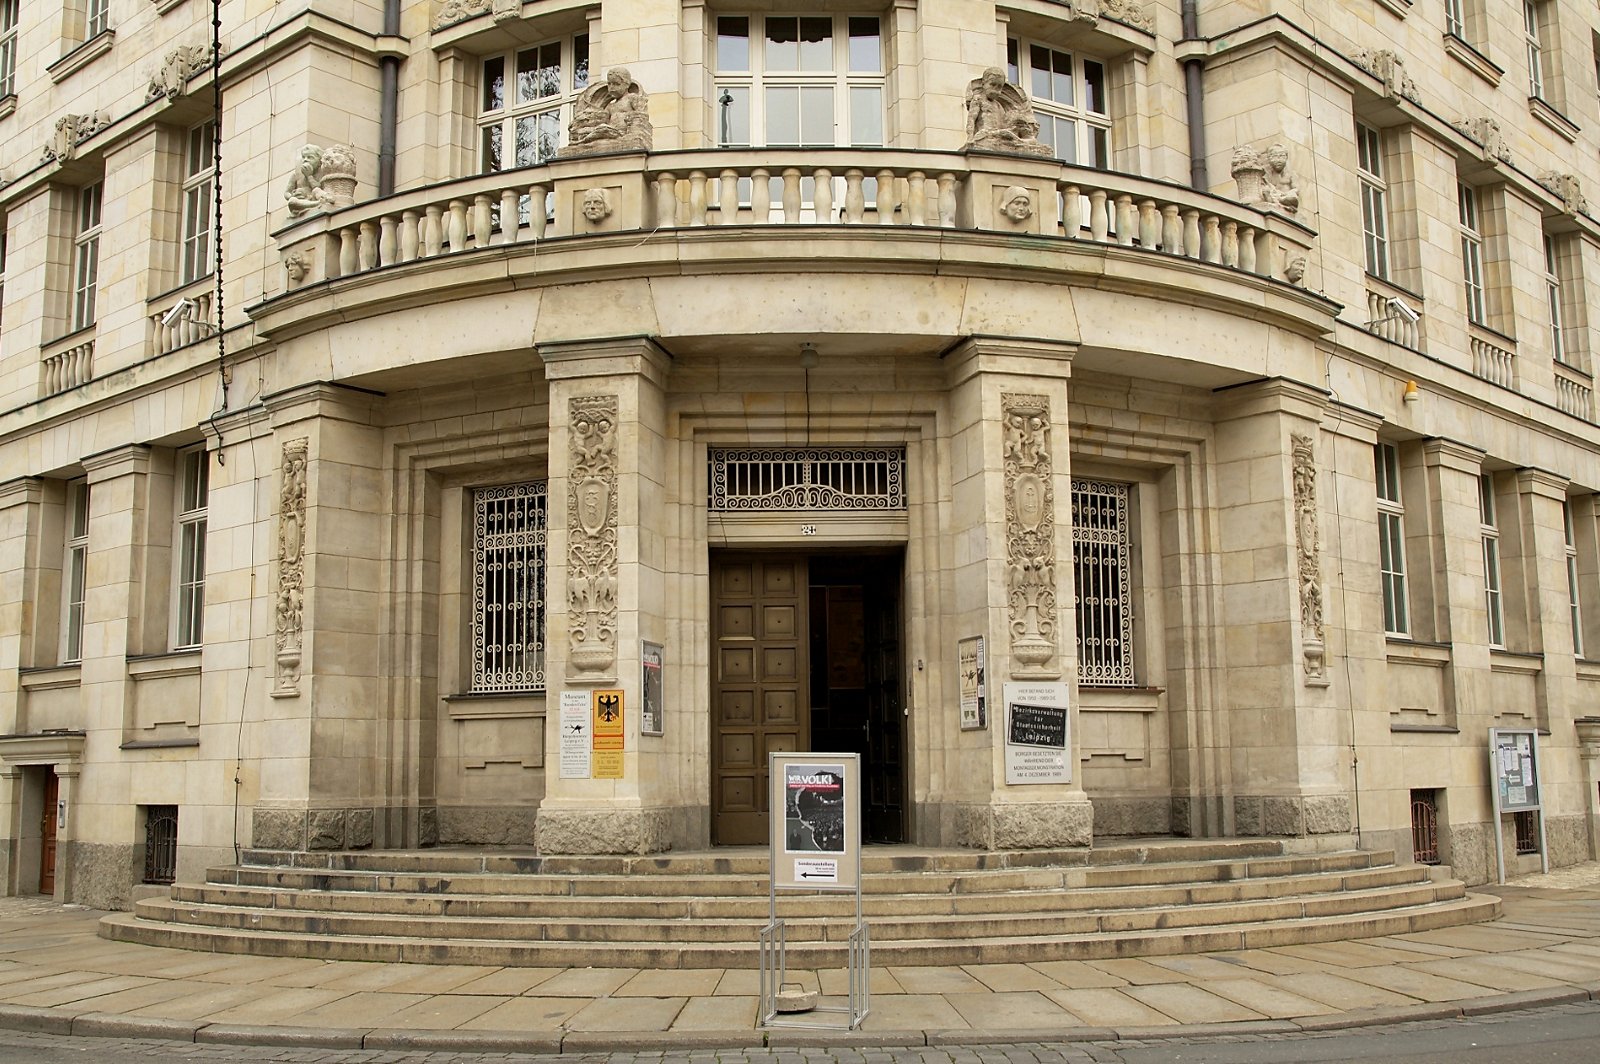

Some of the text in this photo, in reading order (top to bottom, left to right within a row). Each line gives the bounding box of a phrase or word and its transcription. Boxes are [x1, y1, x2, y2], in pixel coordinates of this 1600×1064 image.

[803, 526, 816, 534] 24
[1015, 706, 1063, 718] Bezirksverwaltung
[1016, 722, 1060, 730] Staatssicherheit
[1026, 732, 1050, 742] Leipzig
[802, 774, 832, 784] VOLK!
